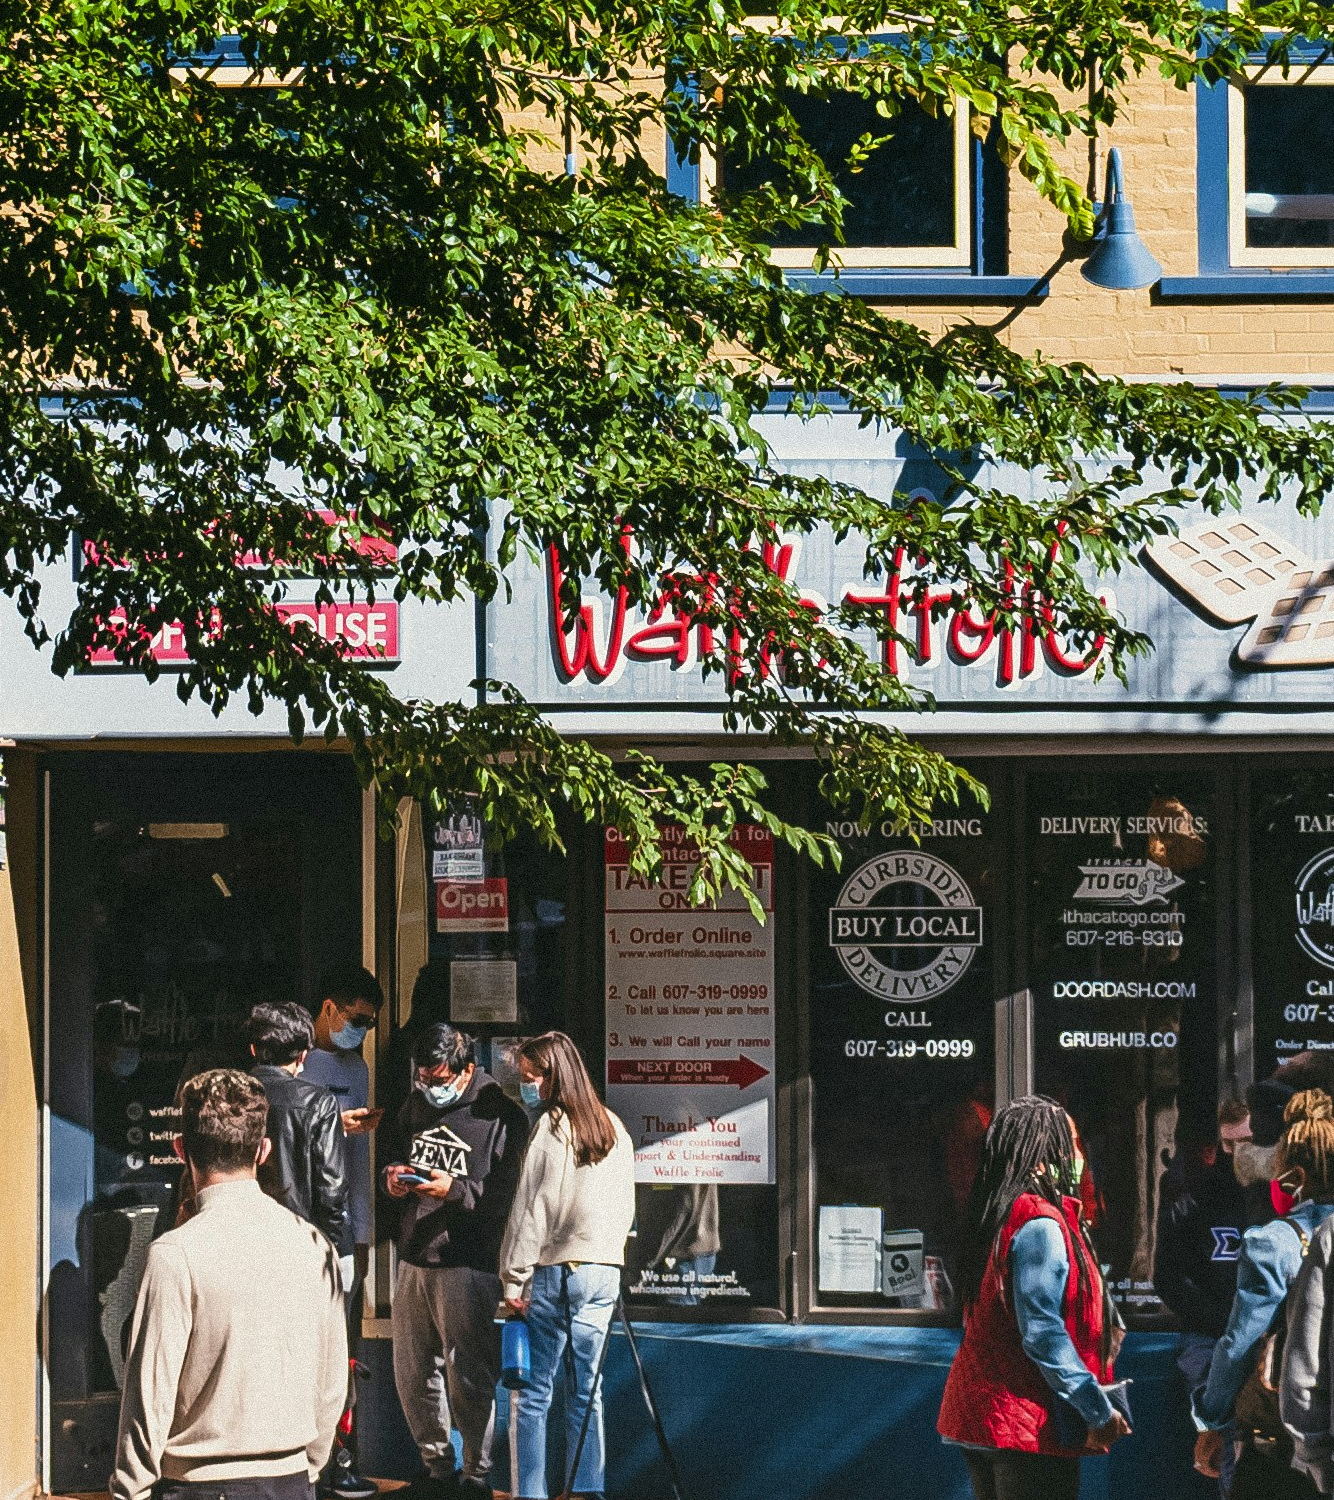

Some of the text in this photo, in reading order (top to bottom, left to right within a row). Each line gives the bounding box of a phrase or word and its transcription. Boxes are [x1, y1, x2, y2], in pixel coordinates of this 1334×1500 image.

[272, 611, 388, 648] OUSE
[826, 821, 871, 838] NOW
[1040, 817, 1120, 834] DELIVERY
[1087, 858, 1143, 867] ITHACA
[848, 858, 965, 906] CURBSIDE
[1086, 874, 1139, 890] TO GO
[441, 885, 505, 913] Open
[1063, 909, 1185, 927] ithacatogo.com
[837, 917, 975, 937] BUY LOCAL
[630, 927, 684, 944] Order
[691, 927, 752, 944] Online
[846, 946, 965, 996] DELIVERY
[628, 985, 656, 999] Call
[662, 985, 768, 1000] 607-319-0999
[1054, 981, 1196, 998] DOORDASH.COM
[705, 1006, 723, 1017] you
[884, 1012, 932, 1027] CALL
[629, 1035, 647, 1047] We
[705, 1036, 731, 1049] your
[845, 1039, 975, 1058] 607-319-0999
[638, 1062, 712, 1073] NEXT DOOR
[642, 1115, 737, 1132] Thank You
[689, 1137, 741, 1147] continued
[683, 1151, 761, 1163] Understanding
[653, 1166, 689, 1177] Waffle
[641, 1270, 738, 1284] We use all natural,
[629, 1281, 688, 1295] wholesome
